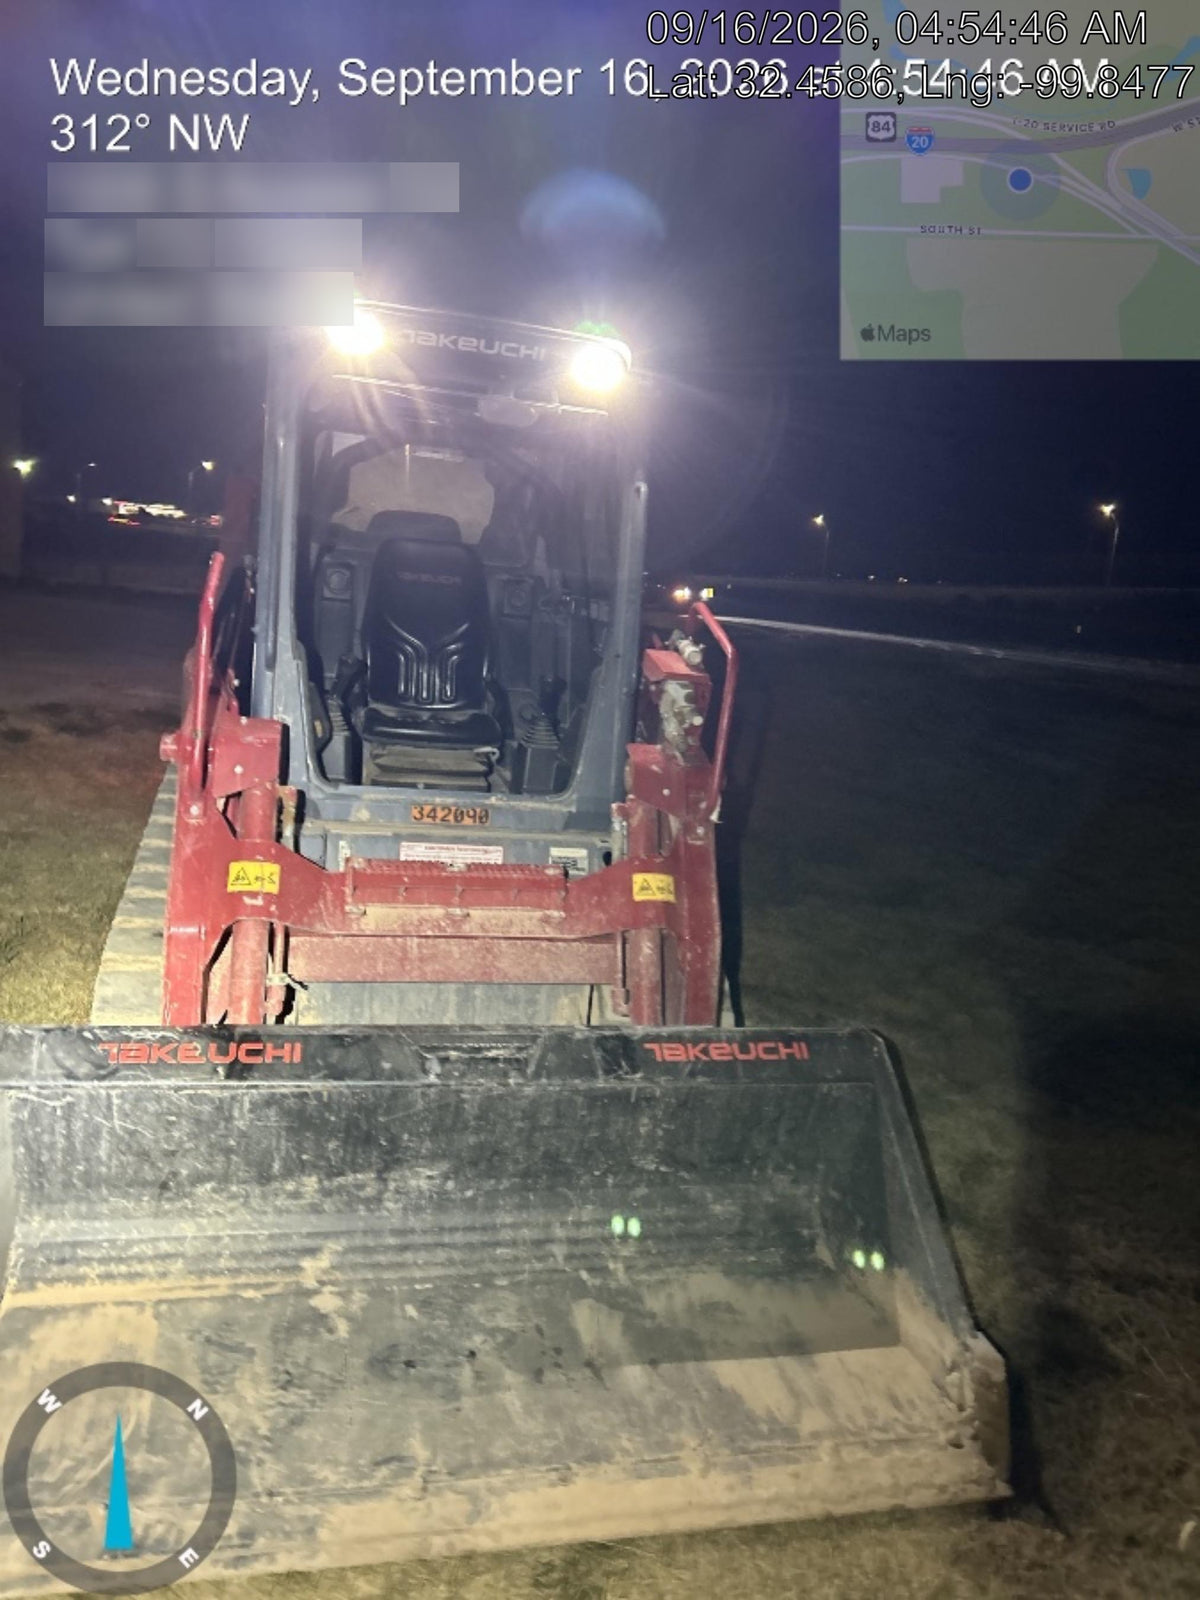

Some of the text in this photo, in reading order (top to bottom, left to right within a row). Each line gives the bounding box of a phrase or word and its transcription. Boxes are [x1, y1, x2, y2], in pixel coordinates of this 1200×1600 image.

[412, 806, 490, 825] 342090
[100, 1041, 303, 1065] TAKEUCHI
[642, 1041, 810, 1063] TAKEUCHI
